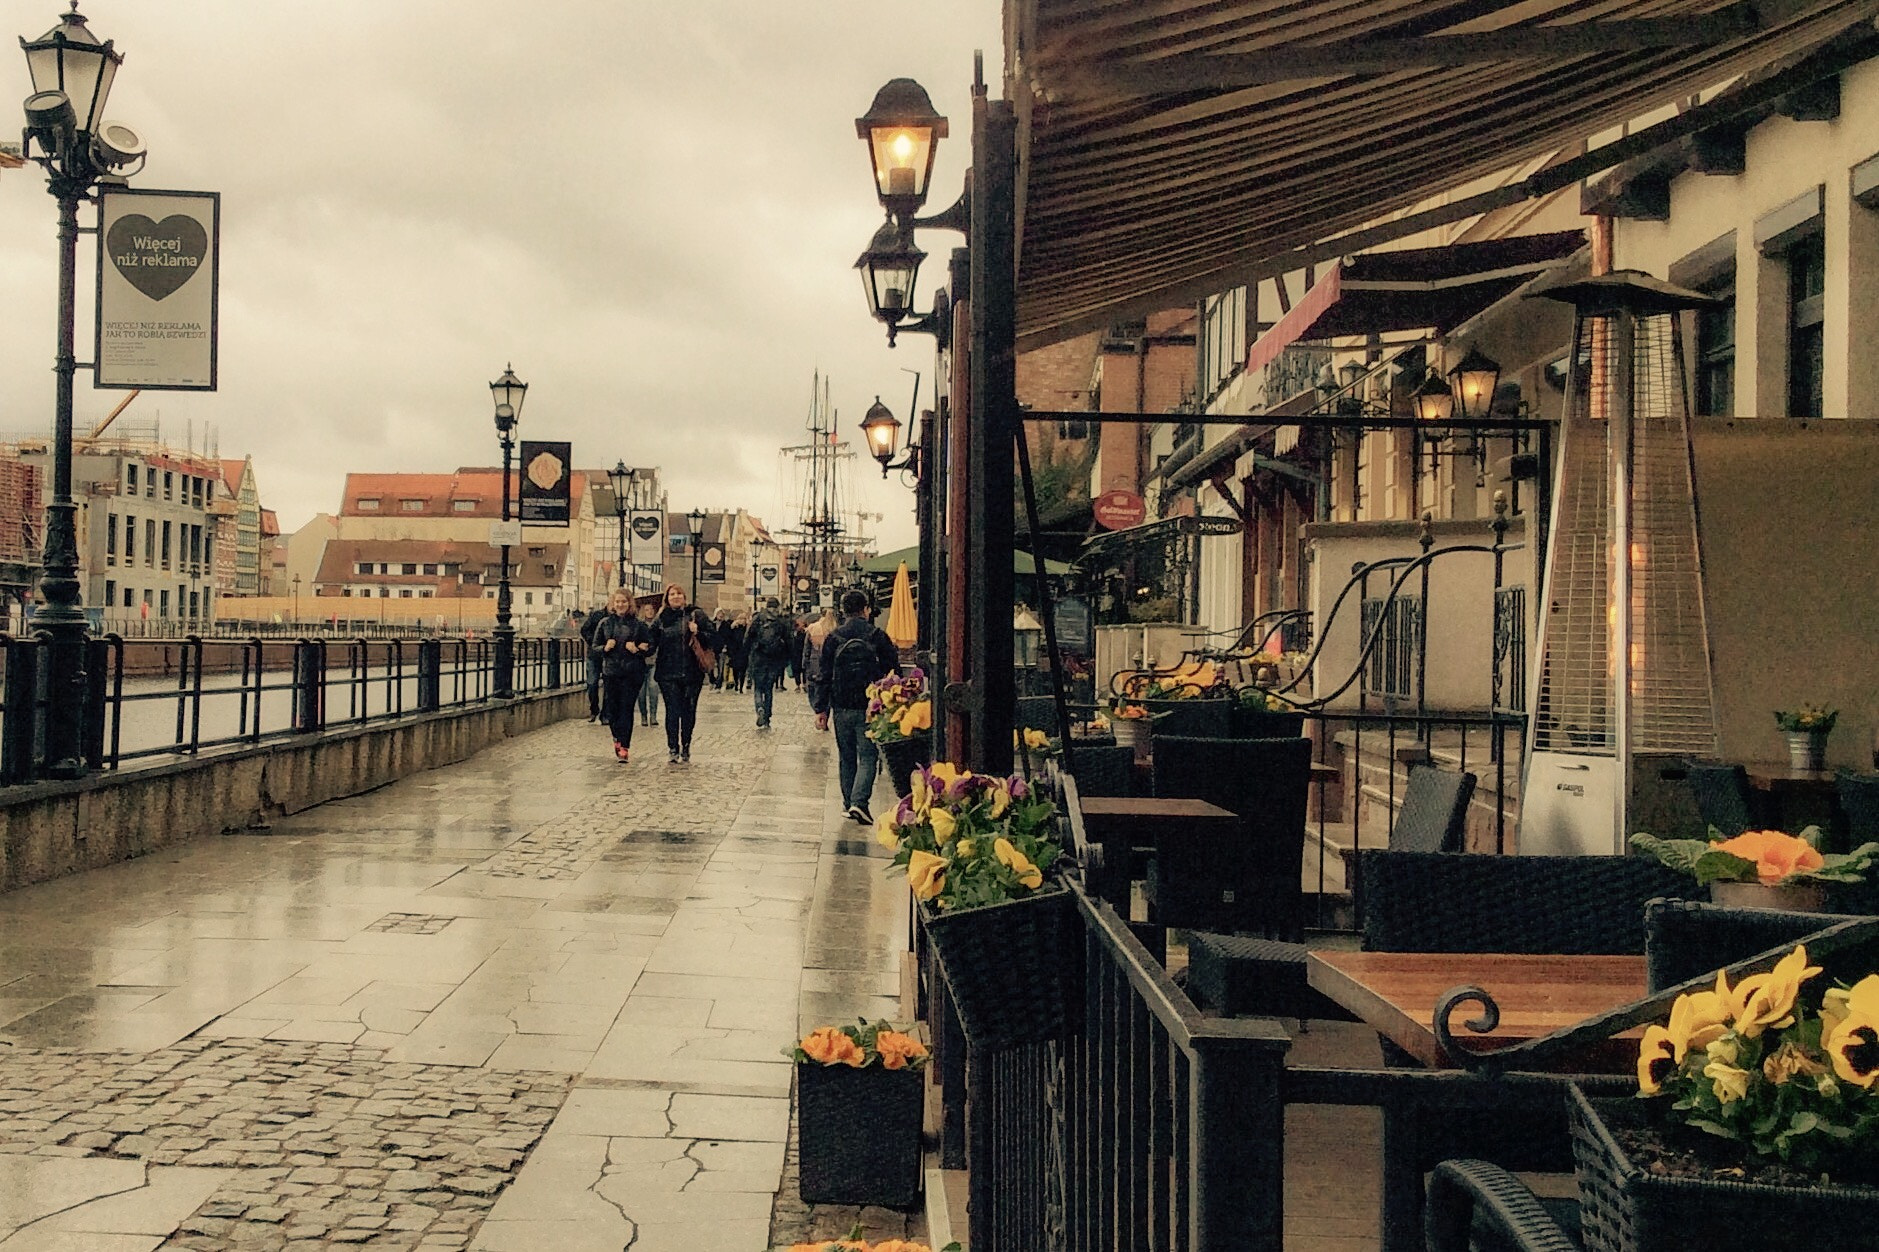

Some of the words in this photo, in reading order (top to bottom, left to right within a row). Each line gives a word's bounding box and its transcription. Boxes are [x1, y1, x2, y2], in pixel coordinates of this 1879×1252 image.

[133, 236, 181, 253] Więcej
[117, 252, 138, 266] niż
[142, 253, 198, 267] reklama
[105, 321, 138, 331] WIĘCEJ
[140, 321, 156, 330] NIŻ
[157, 322, 201, 331] REKLAMA
[105, 331, 121, 339] JAK
[122, 331, 136, 339] TO
[137, 331, 165, 340] ROBIĄ
[166, 332, 206, 340] SZWEDZI
